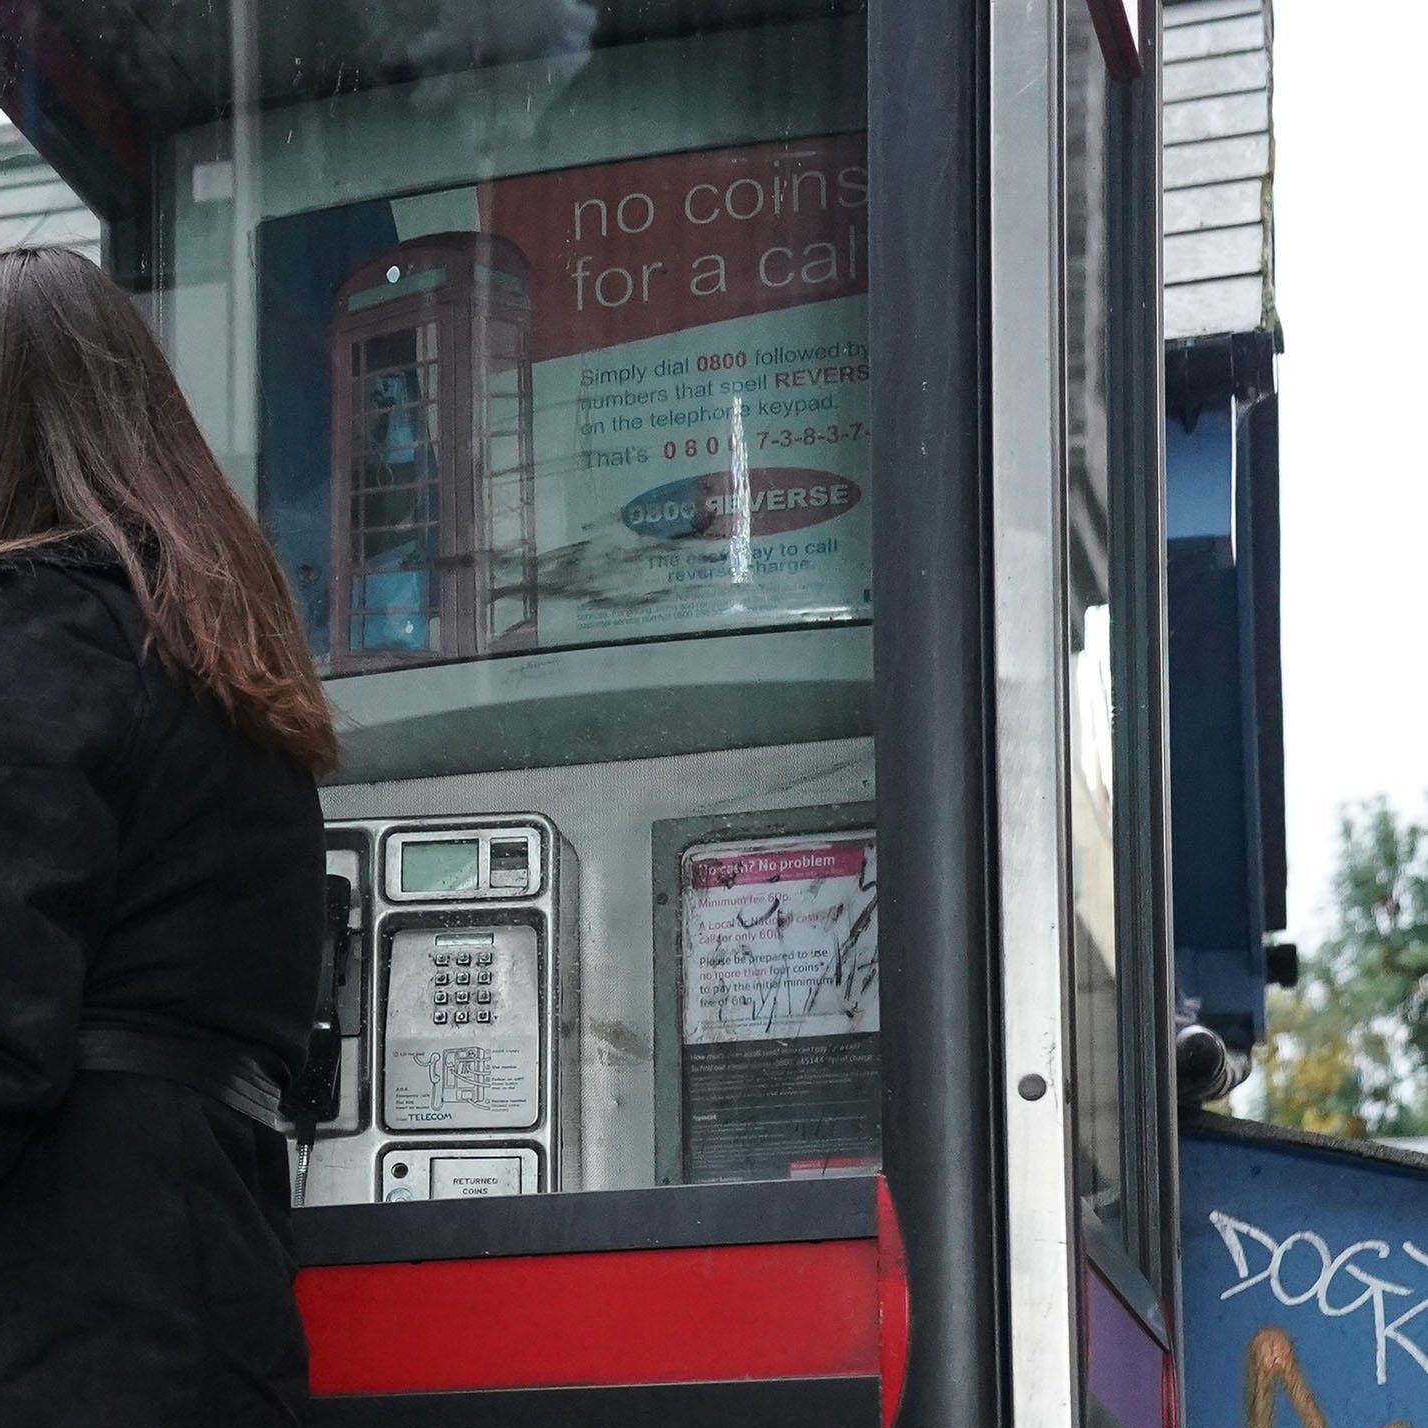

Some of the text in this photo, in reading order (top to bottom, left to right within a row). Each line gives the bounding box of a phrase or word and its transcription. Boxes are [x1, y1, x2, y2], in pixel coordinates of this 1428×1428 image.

[573, 160, 868, 241] no coins
[571, 255, 663, 311] for
[690, 254, 727, 296] a
[580, 362, 648, 387] Simply
[654, 358, 690, 378] dial
[696, 350, 747, 372] 0800
[754, 341, 844, 366] followed
[580, 387, 669, 412] numbers
[675, 381, 714, 402] that
[720, 375, 767, 397] spell
[581, 418, 605, 436] on
[612, 412, 644, 431] the
[583, 446, 649, 470] That's
[781, 542, 797, 558] to
[804, 538, 838, 556] call
[758, 858, 777, 872] No
[779, 854, 836, 873] problem
[698, 896, 746, 909] Minimum
[797, 950, 808, 960] to
[733, 980, 751, 992] the
[408, 1112, 453, 1122] TELECOM
[452, 1177, 498, 1185] RETURNED
[462, 1187, 488, 1195] COINS
